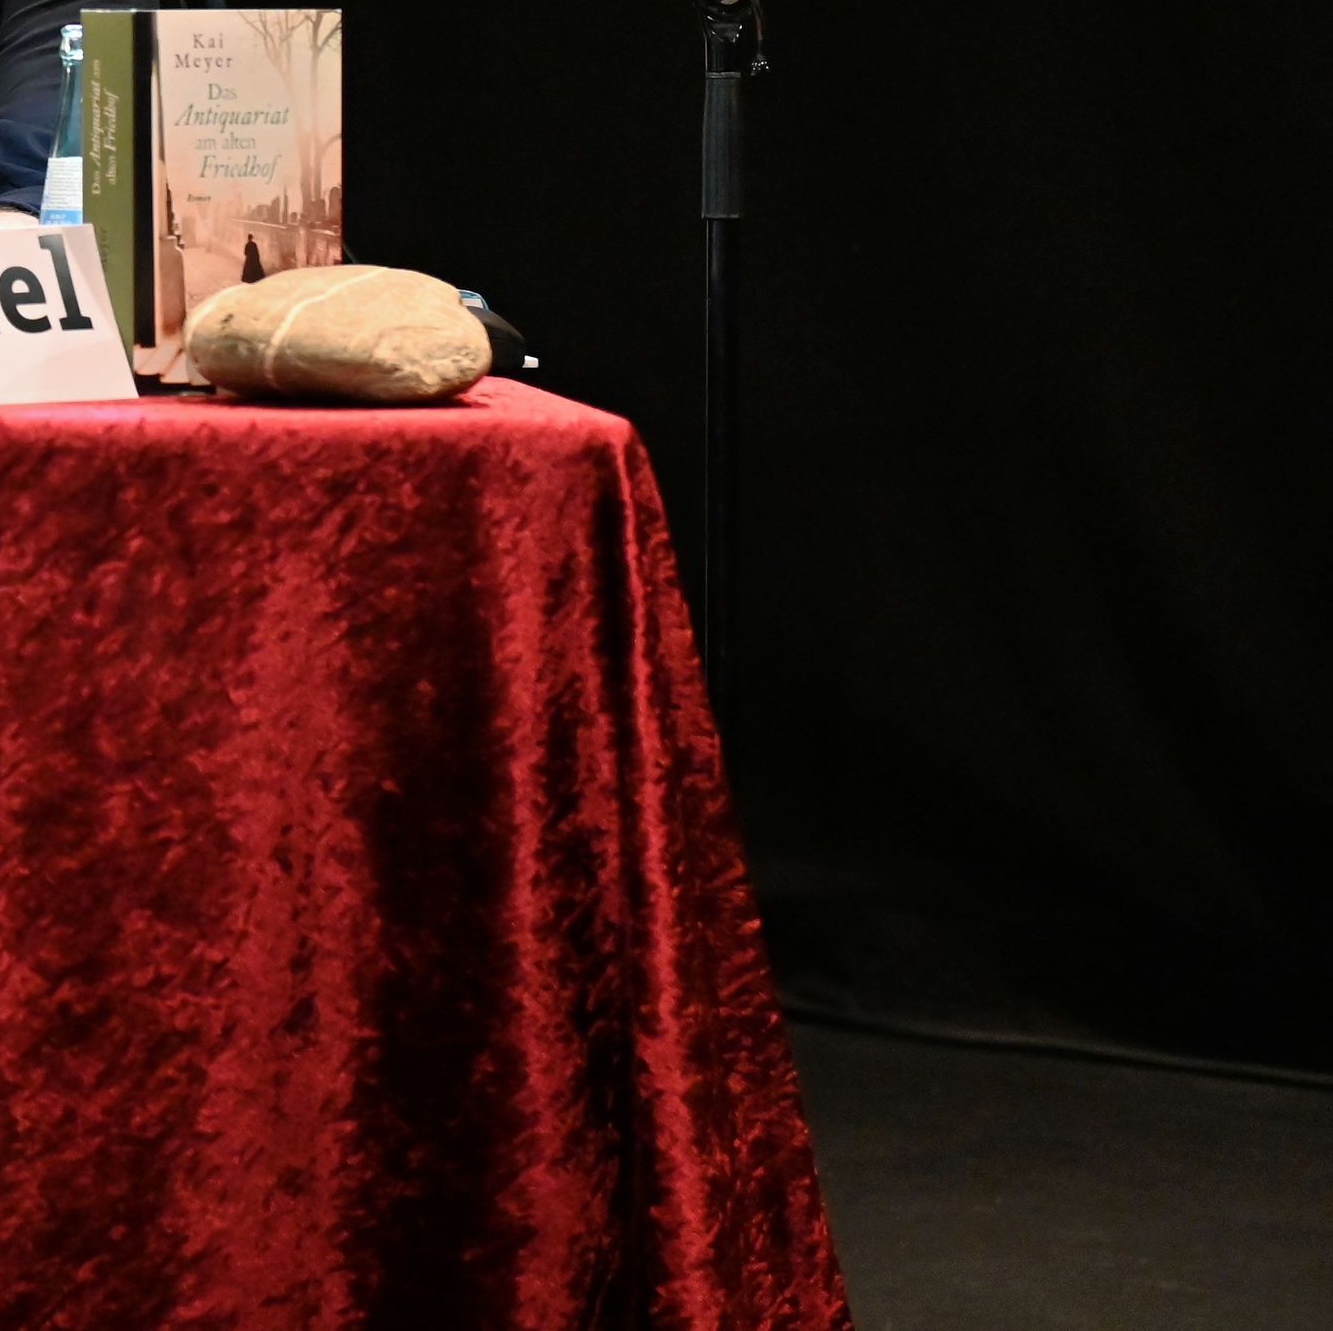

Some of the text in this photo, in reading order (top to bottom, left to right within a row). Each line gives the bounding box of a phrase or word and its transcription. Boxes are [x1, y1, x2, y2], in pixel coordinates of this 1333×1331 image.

[193, 33, 224, 49] Kai
[175, 54, 233, 73] Meyer
[207, 83, 237, 100] Das
[174, 103, 290, 133] Antiquariat
[194, 131, 257, 150] am alten
[200, 155, 283, 185] Friedhof
